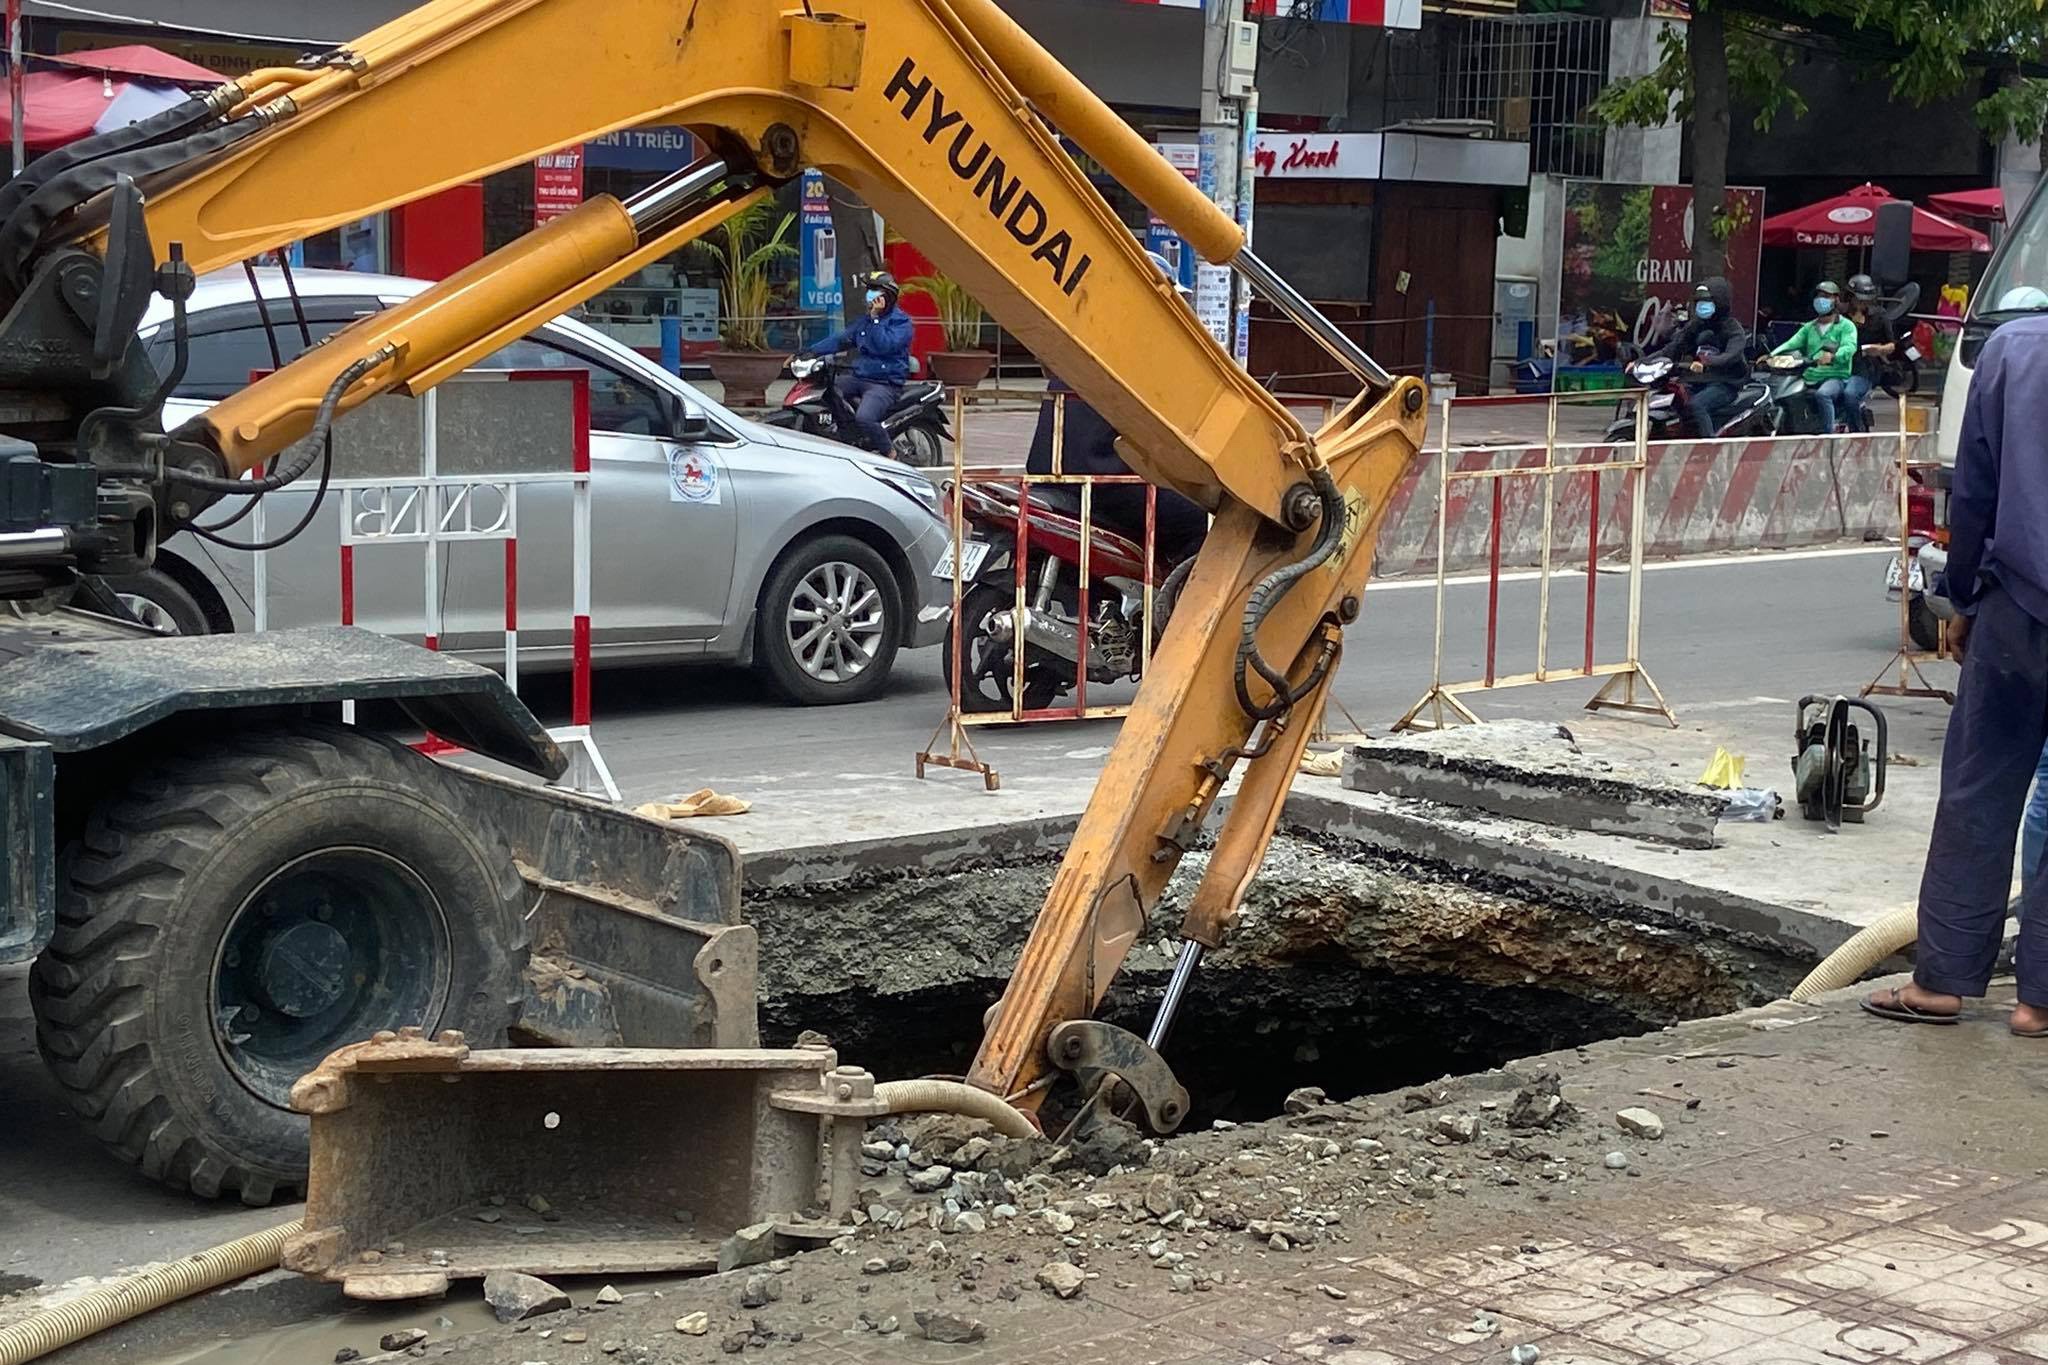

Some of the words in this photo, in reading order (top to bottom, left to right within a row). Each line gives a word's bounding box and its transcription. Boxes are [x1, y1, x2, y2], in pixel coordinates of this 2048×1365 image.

[624, 131, 631, 147] 1
[635, 130, 684, 153] TRIỆU
[883, 56, 1092, 297] HYUNDAI
[1815, 233, 1840, 245] Phê
[808, 290, 843, 304] VEGO
